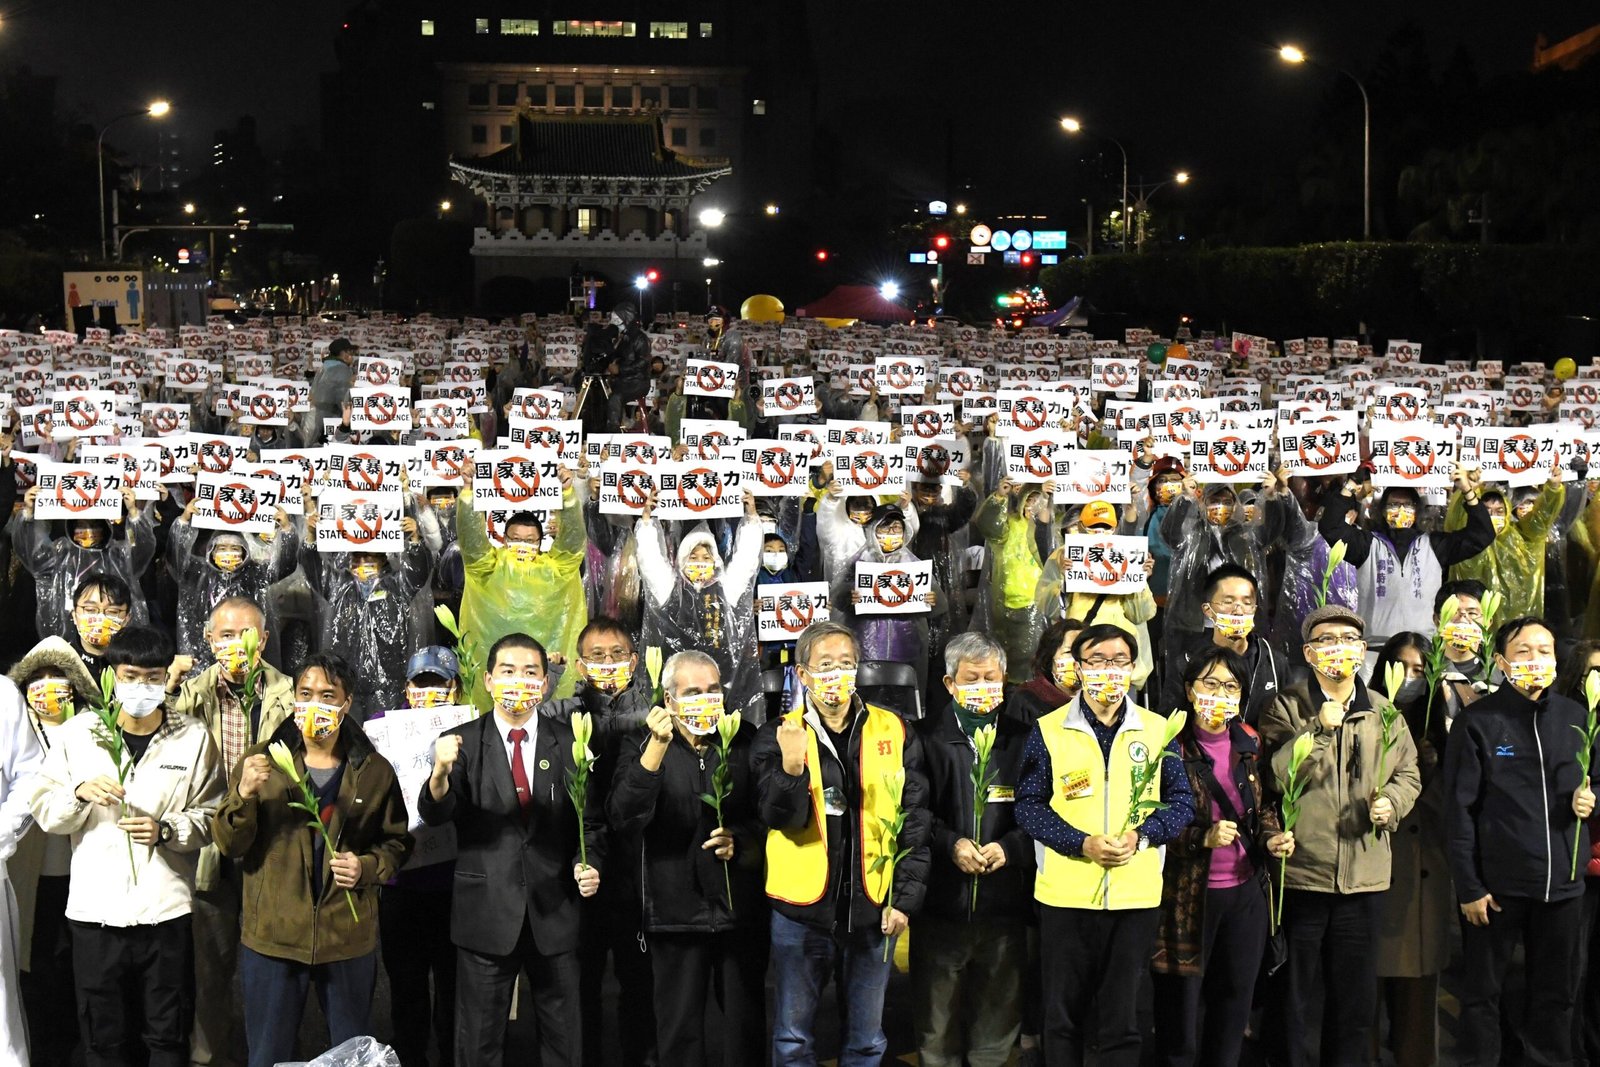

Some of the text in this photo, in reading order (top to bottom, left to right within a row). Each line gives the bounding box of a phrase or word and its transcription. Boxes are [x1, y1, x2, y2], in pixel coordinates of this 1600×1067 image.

[90, 299, 119, 308] Toilet
[687, 365, 737, 380] 國家暴力
[1093, 365, 1138, 376] 國家暴力
[764, 384, 814, 398] 國家暴力
[53, 399, 113, 413] 國家暴力
[240, 396, 288, 408] 國家暴力
[351, 397, 410, 409] 國家暴力
[512, 394, 562, 410] 國家暴力
[998, 399, 1061, 413] 國家暴力
[351, 413, 410, 421] STATE VIOLENCE
[903, 412, 953, 425] 國家暴力
[997, 418, 1020, 427] STATE
[1152, 410, 1219, 427] 國家暴力
[511, 427, 580, 444] 國家暴力
[1282, 430, 1356, 452] 國家暴力
[1193, 440, 1266, 456] 國家暴力
[1372, 440, 1453, 456] 國家暴力
[1483, 438, 1554, 454] 國家暴力
[742, 448, 808, 468] 國家暴力
[905, 446, 964, 463] 國家暴力
[1315, 453, 1357, 464] VIOLENCE
[330, 455, 401, 477] 國家暴力
[836, 454, 904, 470] 國家暴力
[1009, 464, 1033, 473] STATE
[1193, 463, 1266, 472] STATE VIOLENCE
[1481, 459, 1553, 471] STATE VIOLENCE
[475, 460, 558, 480] 國家暴力
[1373, 465, 1452, 475] STATE VIOLENCE
[40, 475, 120, 490] 國家暴力
[123, 481, 157, 489] OLENCE
[326, 479, 352, 489] STATE
[603, 472, 654, 489] 國家暴
[660, 470, 740, 490] 國家暴力
[770, 474, 807, 485] VIOLENCE
[864, 476, 904, 485] VIOLENCE
[475, 487, 559, 498] STATE VIOLENCE
[1056, 483, 1127, 492] STATE VIOLENCE
[198, 483, 277, 507] 國家暴力
[602, 493, 627, 503] STATE
[660, 495, 740, 509] STATE VIOLENCE
[38, 498, 119, 508] STATE VIOLENCE
[228, 510, 273, 523] VIOLENCE
[320, 503, 401, 521] 國家暴力
[319, 530, 401, 540] STATE VIOLENCE
[1068, 545, 1146, 567] 國家暴力
[857, 571, 929, 588] 國家暴力
[1067, 570, 1145, 583] STATE VIOLENCE
[761, 593, 828, 613] 國家暴力
[760, 619, 785, 630] STATE
[877, 740, 892, 755] 打
